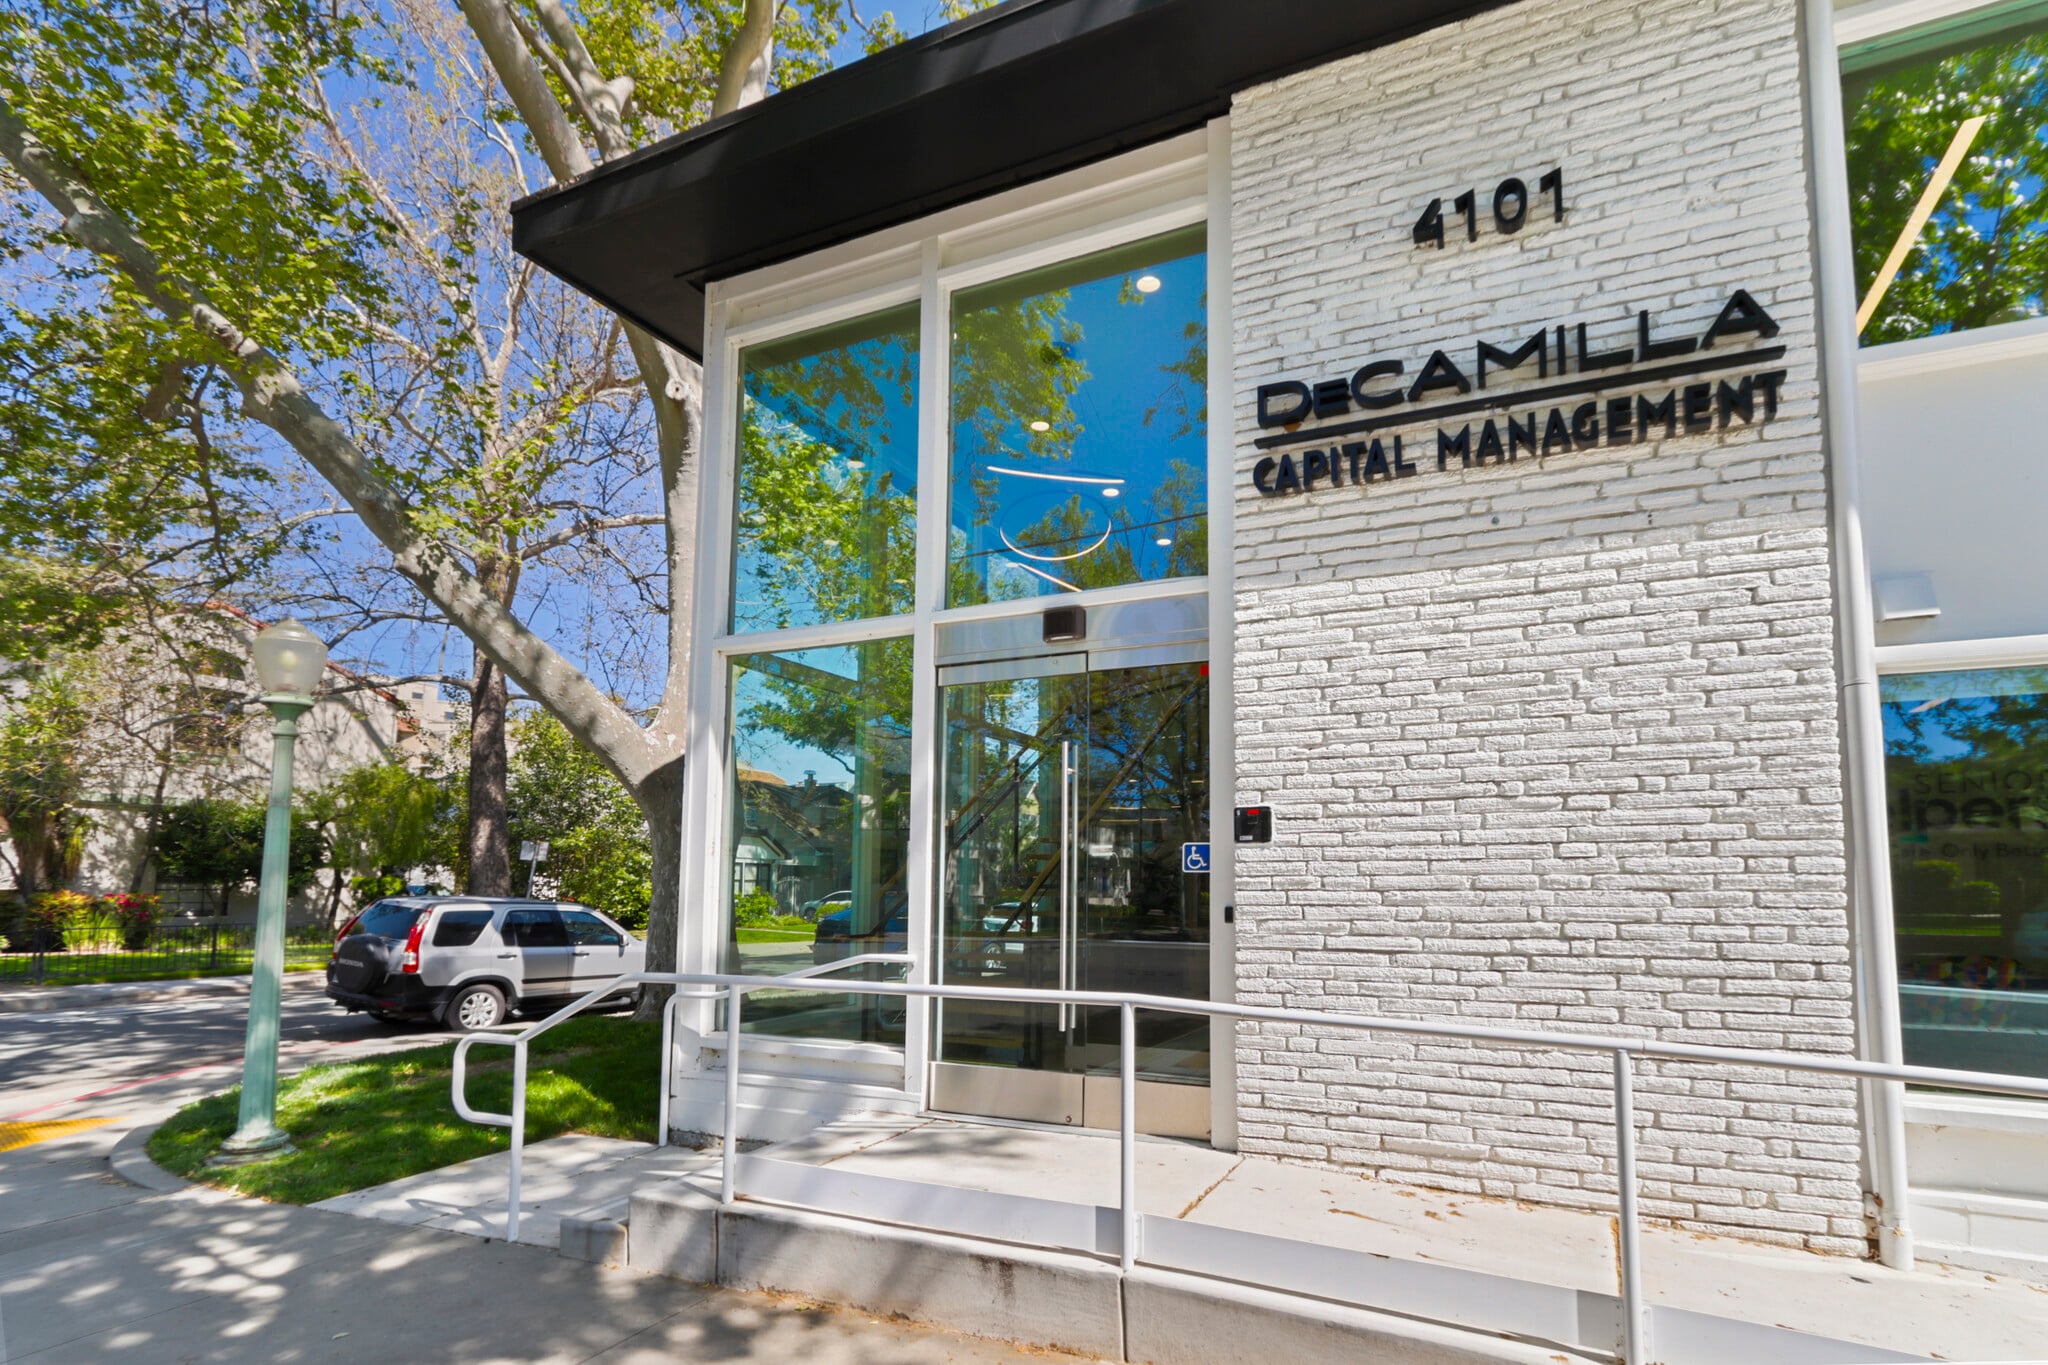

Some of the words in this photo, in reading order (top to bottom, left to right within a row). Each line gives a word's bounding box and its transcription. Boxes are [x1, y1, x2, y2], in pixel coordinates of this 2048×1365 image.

[1412, 166, 1563, 250] 4101
[1252, 435, 1417, 495] CAPITAL
[1437, 369, 1788, 472] MANAGEMENT
[1889, 787, 2048, 842] lper
